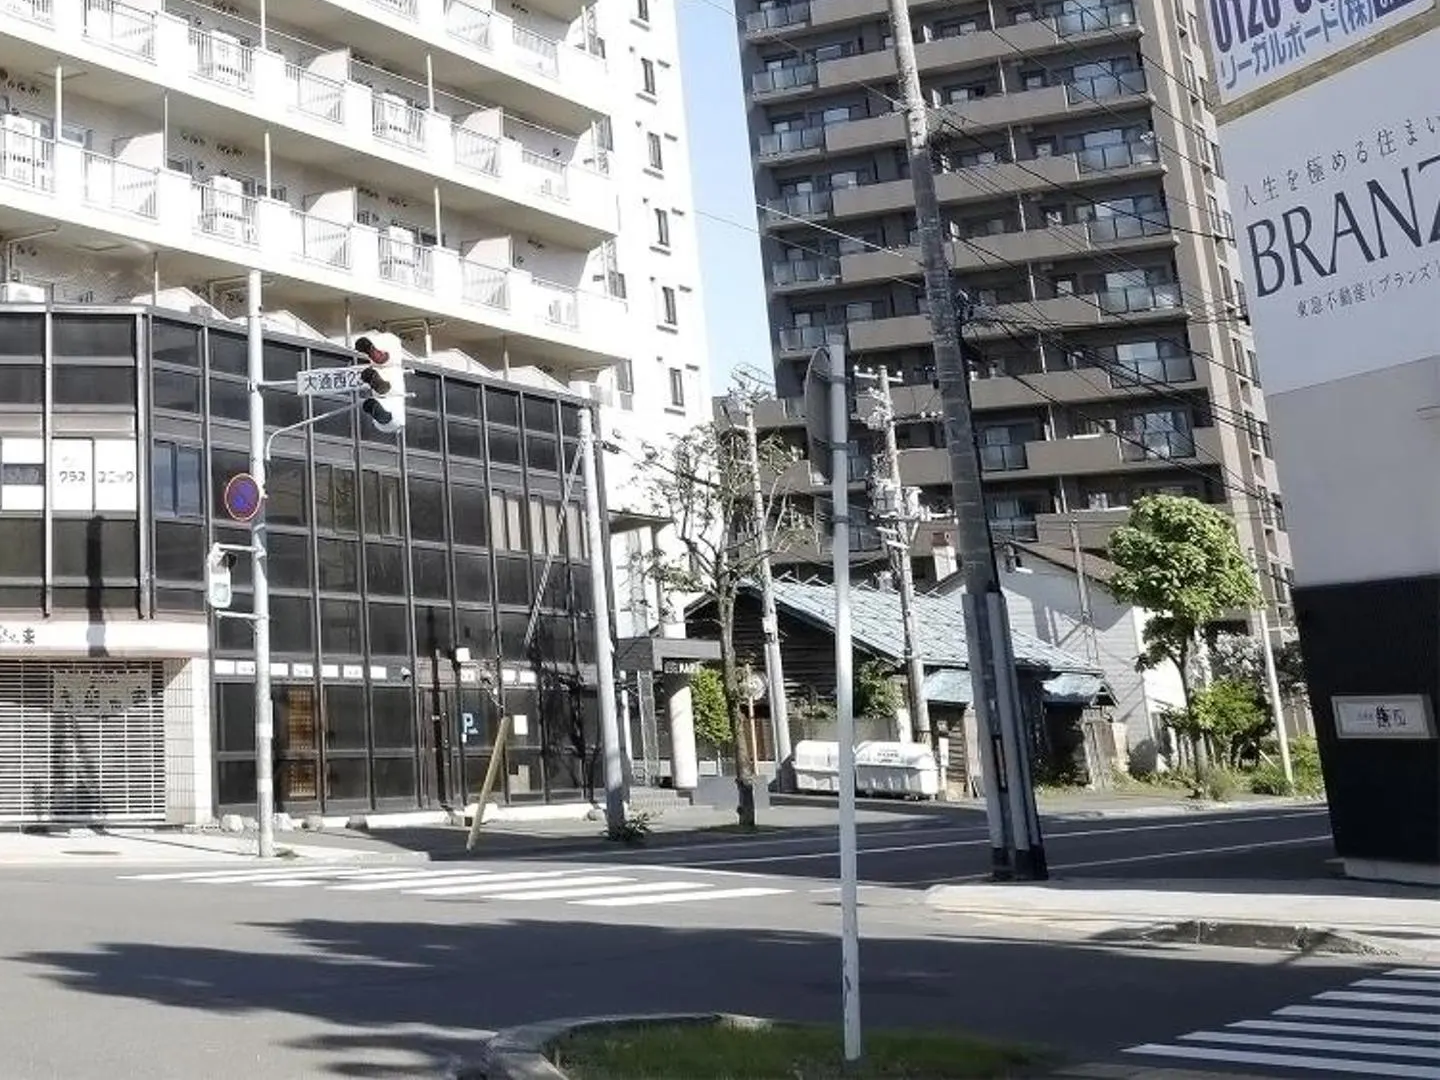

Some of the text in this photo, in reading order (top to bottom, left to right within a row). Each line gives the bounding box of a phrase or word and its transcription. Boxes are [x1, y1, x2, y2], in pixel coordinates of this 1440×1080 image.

[1243, 115, 1440, 207] 人生を極める住まい
